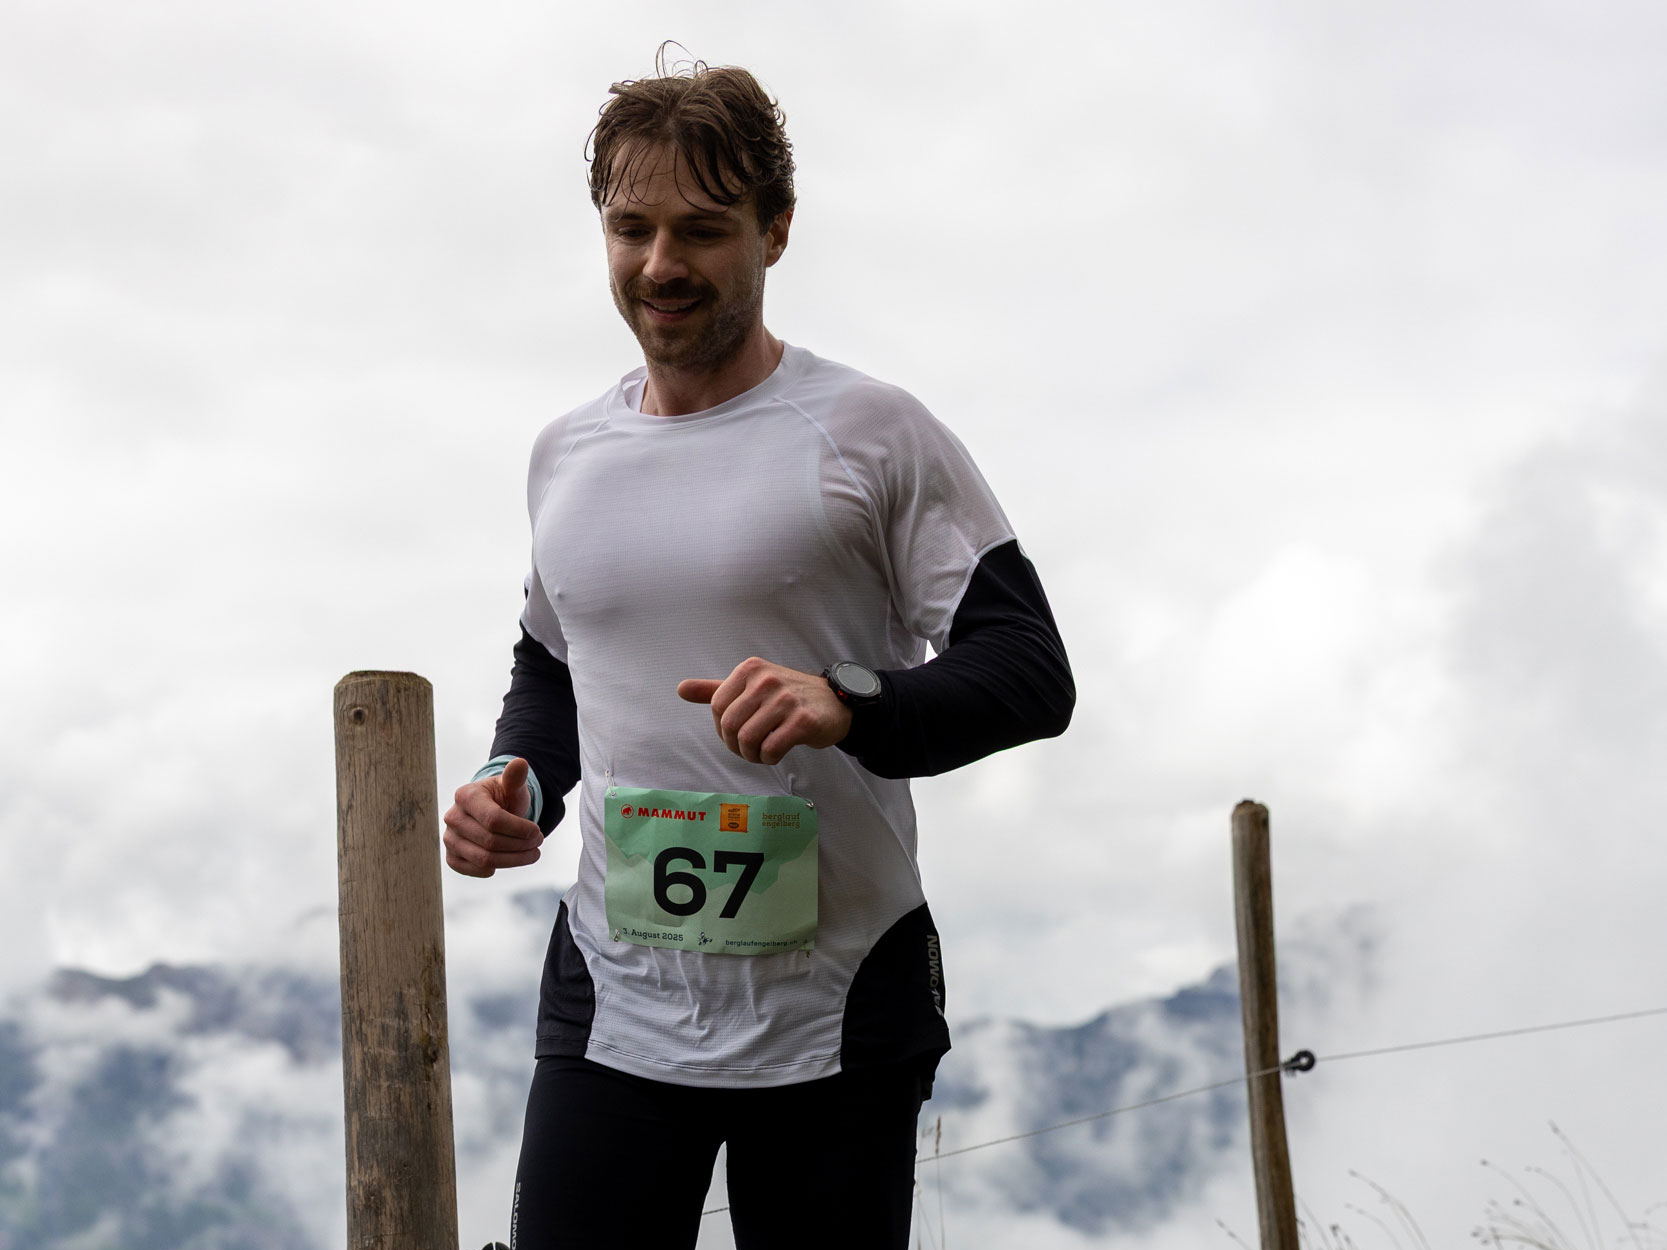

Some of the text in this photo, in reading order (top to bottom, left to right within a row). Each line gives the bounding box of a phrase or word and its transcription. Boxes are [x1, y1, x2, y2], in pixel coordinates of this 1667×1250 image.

[638, 807, 707, 821] MAMMUT
[762, 812, 800, 822] berglauf
[762, 820, 800, 829] engelberg
[653, 846, 765, 919] 67
[622, 927, 684, 942] 3. August 2025
